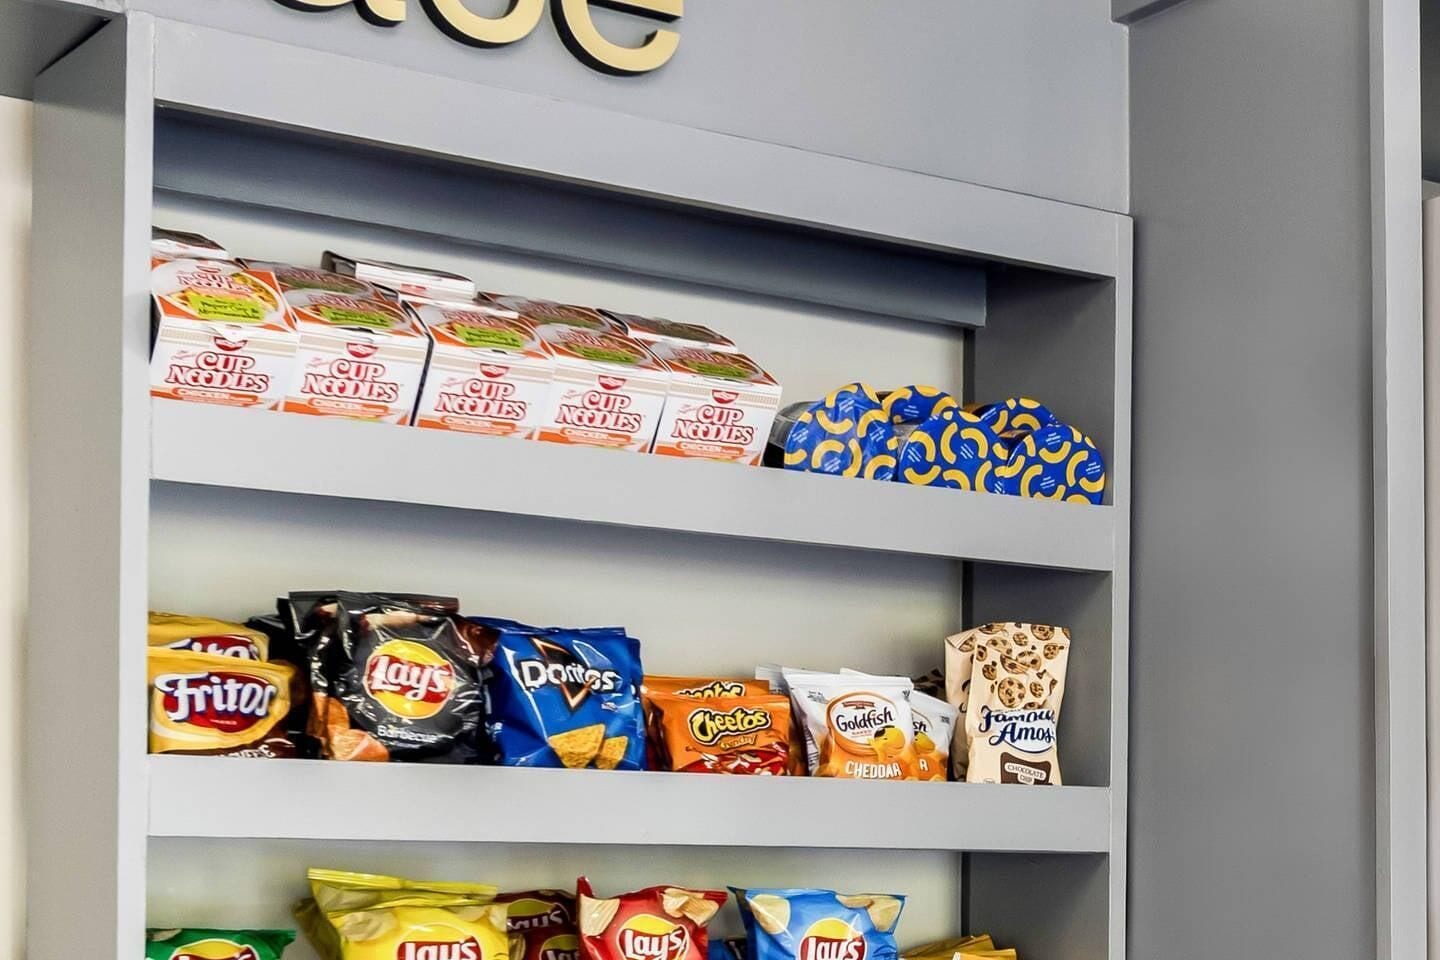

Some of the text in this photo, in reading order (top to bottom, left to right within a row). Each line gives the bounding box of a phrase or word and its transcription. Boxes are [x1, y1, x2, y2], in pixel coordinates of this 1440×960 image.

[196, 351, 255, 373] CUP
[330, 359, 385, 381] CUP
[165, 364, 269, 392] NOODLES
[301, 373, 399, 403] NOODLES
[463, 378, 515, 400] CUP
[435, 392, 526, 420] NOODLES
[582, 390, 631, 412] CUP
[555, 404, 642, 432] NOODLES
[697, 405, 743, 425] CUP
[671, 419, 753, 445] NOODLES
[370, 655, 450, 701] Lay's
[520, 661, 620, 691] Doritos
[155, 672, 276, 720] Fritos
[690, 708, 769, 743] Cheetos
[836, 706, 894, 732] Goldfish
[845, 760, 902, 778] CHEDDAR
[1007, 764, 1044, 779] CHOCOLATE
